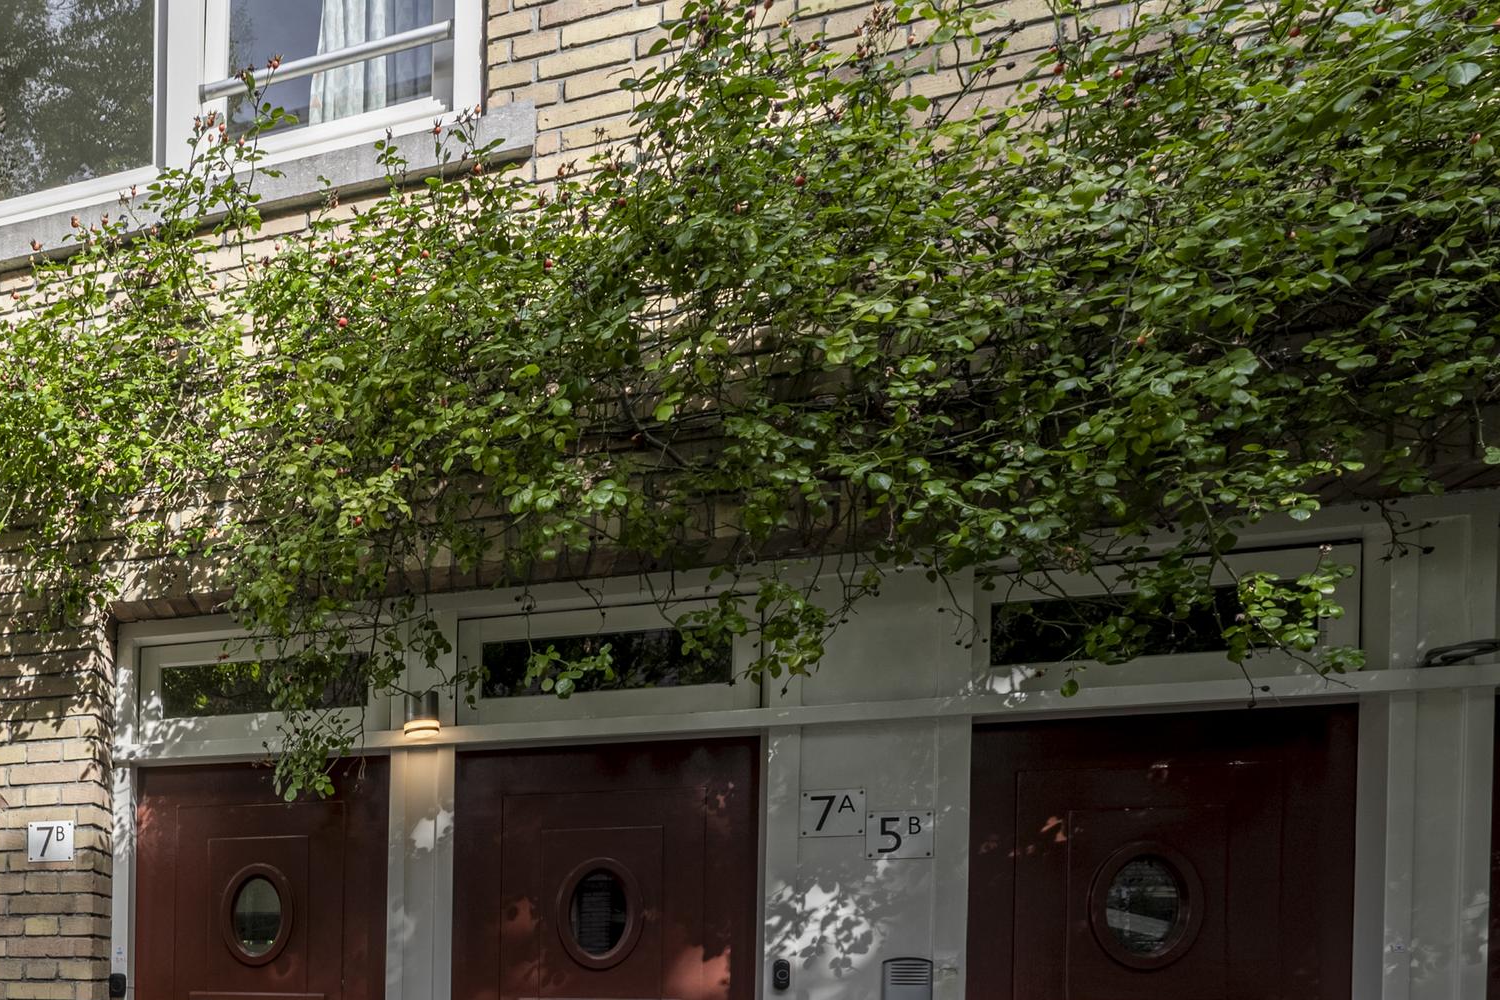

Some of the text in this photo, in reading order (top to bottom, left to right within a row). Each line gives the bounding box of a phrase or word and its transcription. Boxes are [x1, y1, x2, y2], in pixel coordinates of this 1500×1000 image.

[810, 794, 856, 832] 7A
[36, 825, 66, 858] 7B
[877, 816, 922, 854] 5B
